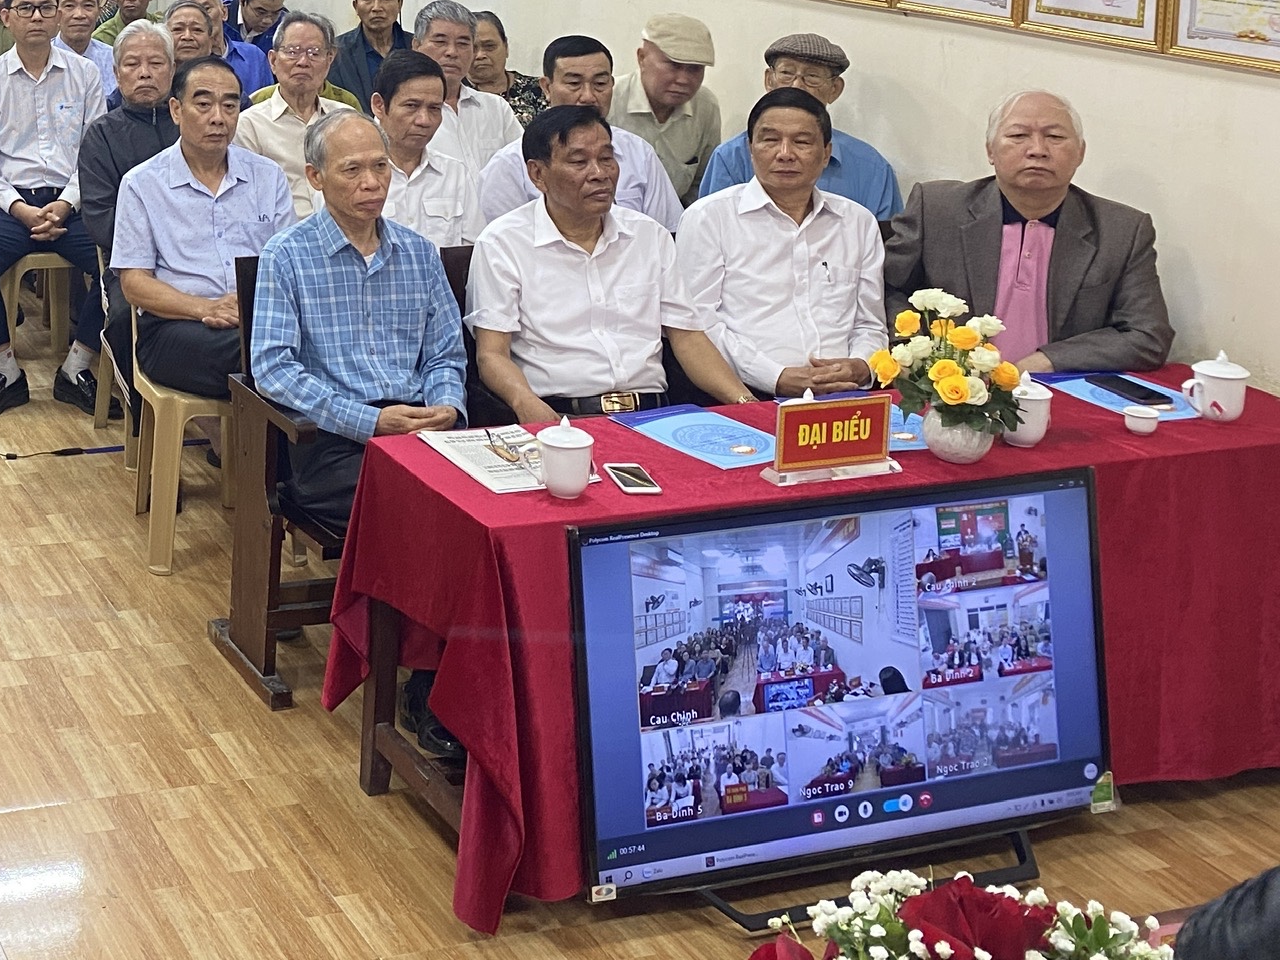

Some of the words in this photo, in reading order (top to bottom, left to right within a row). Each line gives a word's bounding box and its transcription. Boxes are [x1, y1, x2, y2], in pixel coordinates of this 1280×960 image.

[798, 422, 827, 449] ĐẠI
[831, 410, 871, 442] BIỂU
[926, 583, 941, 591] Cau
[972, 577, 977, 586] 2
[931, 673, 942, 683] Ba
[969, 669, 974, 677] 2
[650, 715, 668, 725] Cau
[671, 709, 698, 723] Chinh
[937, 764, 958, 776] Ngoc
[960, 759, 980, 770] Trao
[800, 785, 822, 799] Ngoc
[824, 782, 844, 793] Trao
[847, 780, 853, 789] 9
[656, 811, 668, 821] Ba
[672, 806, 694, 819] Dinh
